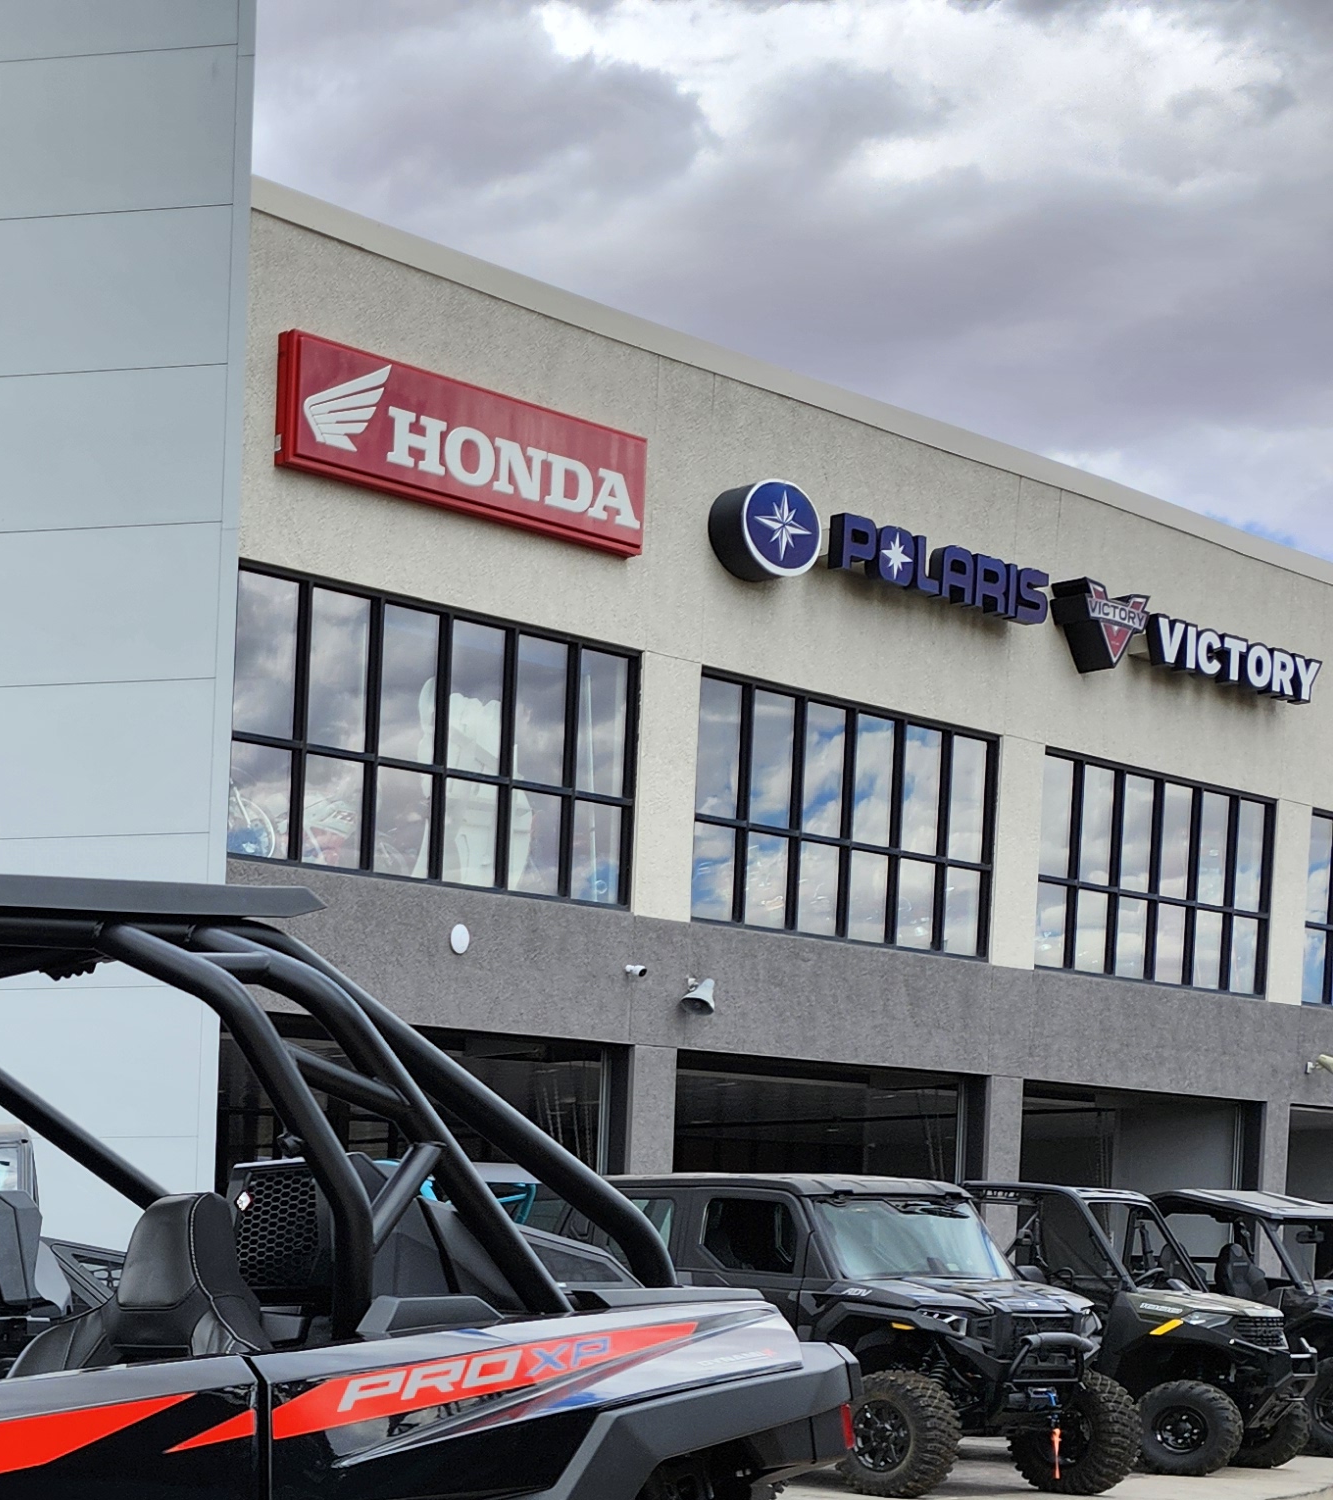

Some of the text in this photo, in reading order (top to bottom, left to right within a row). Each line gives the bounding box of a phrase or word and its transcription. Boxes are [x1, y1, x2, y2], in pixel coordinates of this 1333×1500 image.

[385, 404, 641, 530] HONDA
[831, 513, 1050, 625] POLARIS
[1088, 600, 1145, 629] VICTORY
[1153, 613, 1323, 703] VICTORY
[840, 1287, 873, 1297] ADV
[336, 1336, 610, 1413] PRO XP
